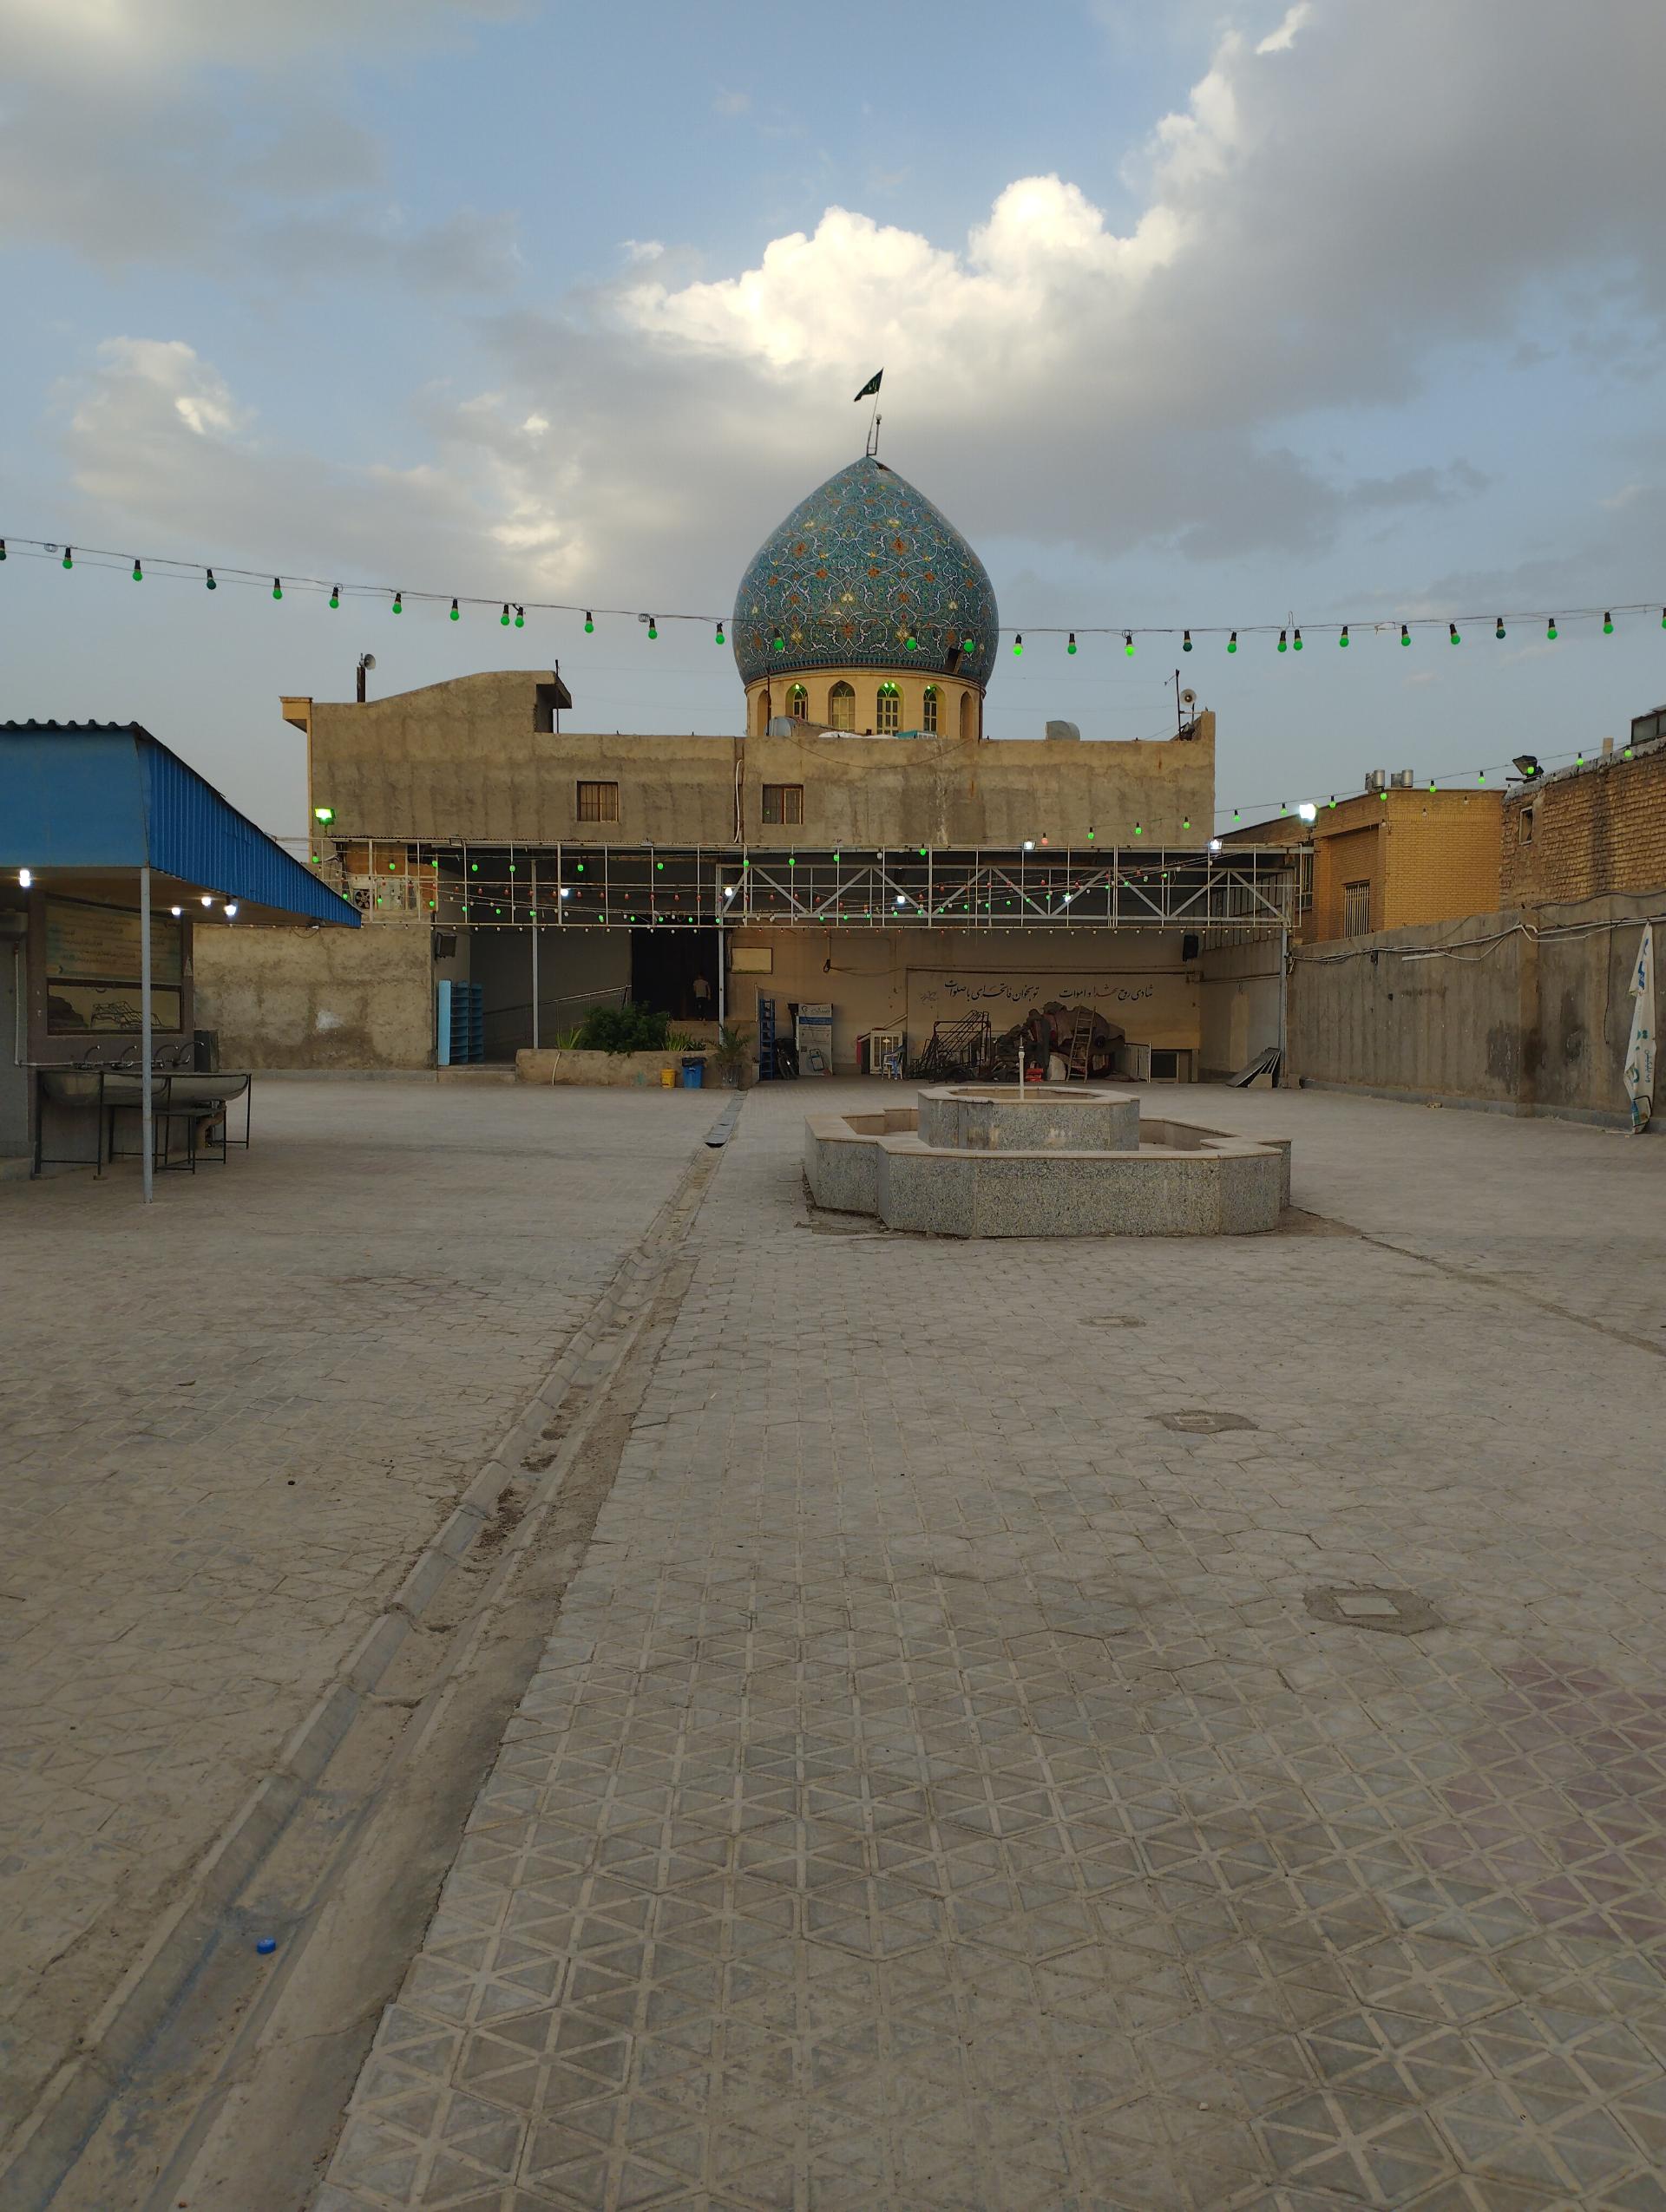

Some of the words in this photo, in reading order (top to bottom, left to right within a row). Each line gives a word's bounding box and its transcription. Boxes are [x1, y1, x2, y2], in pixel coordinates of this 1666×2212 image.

[944, 980, 967, 997] صلوات
[1012, 985, 1034, 1001] بخوان
[1059, 989, 1086, 998] اموات
[1118, 989, 1131, 1000] روح
[1131, 984, 1153, 1000] شادی
